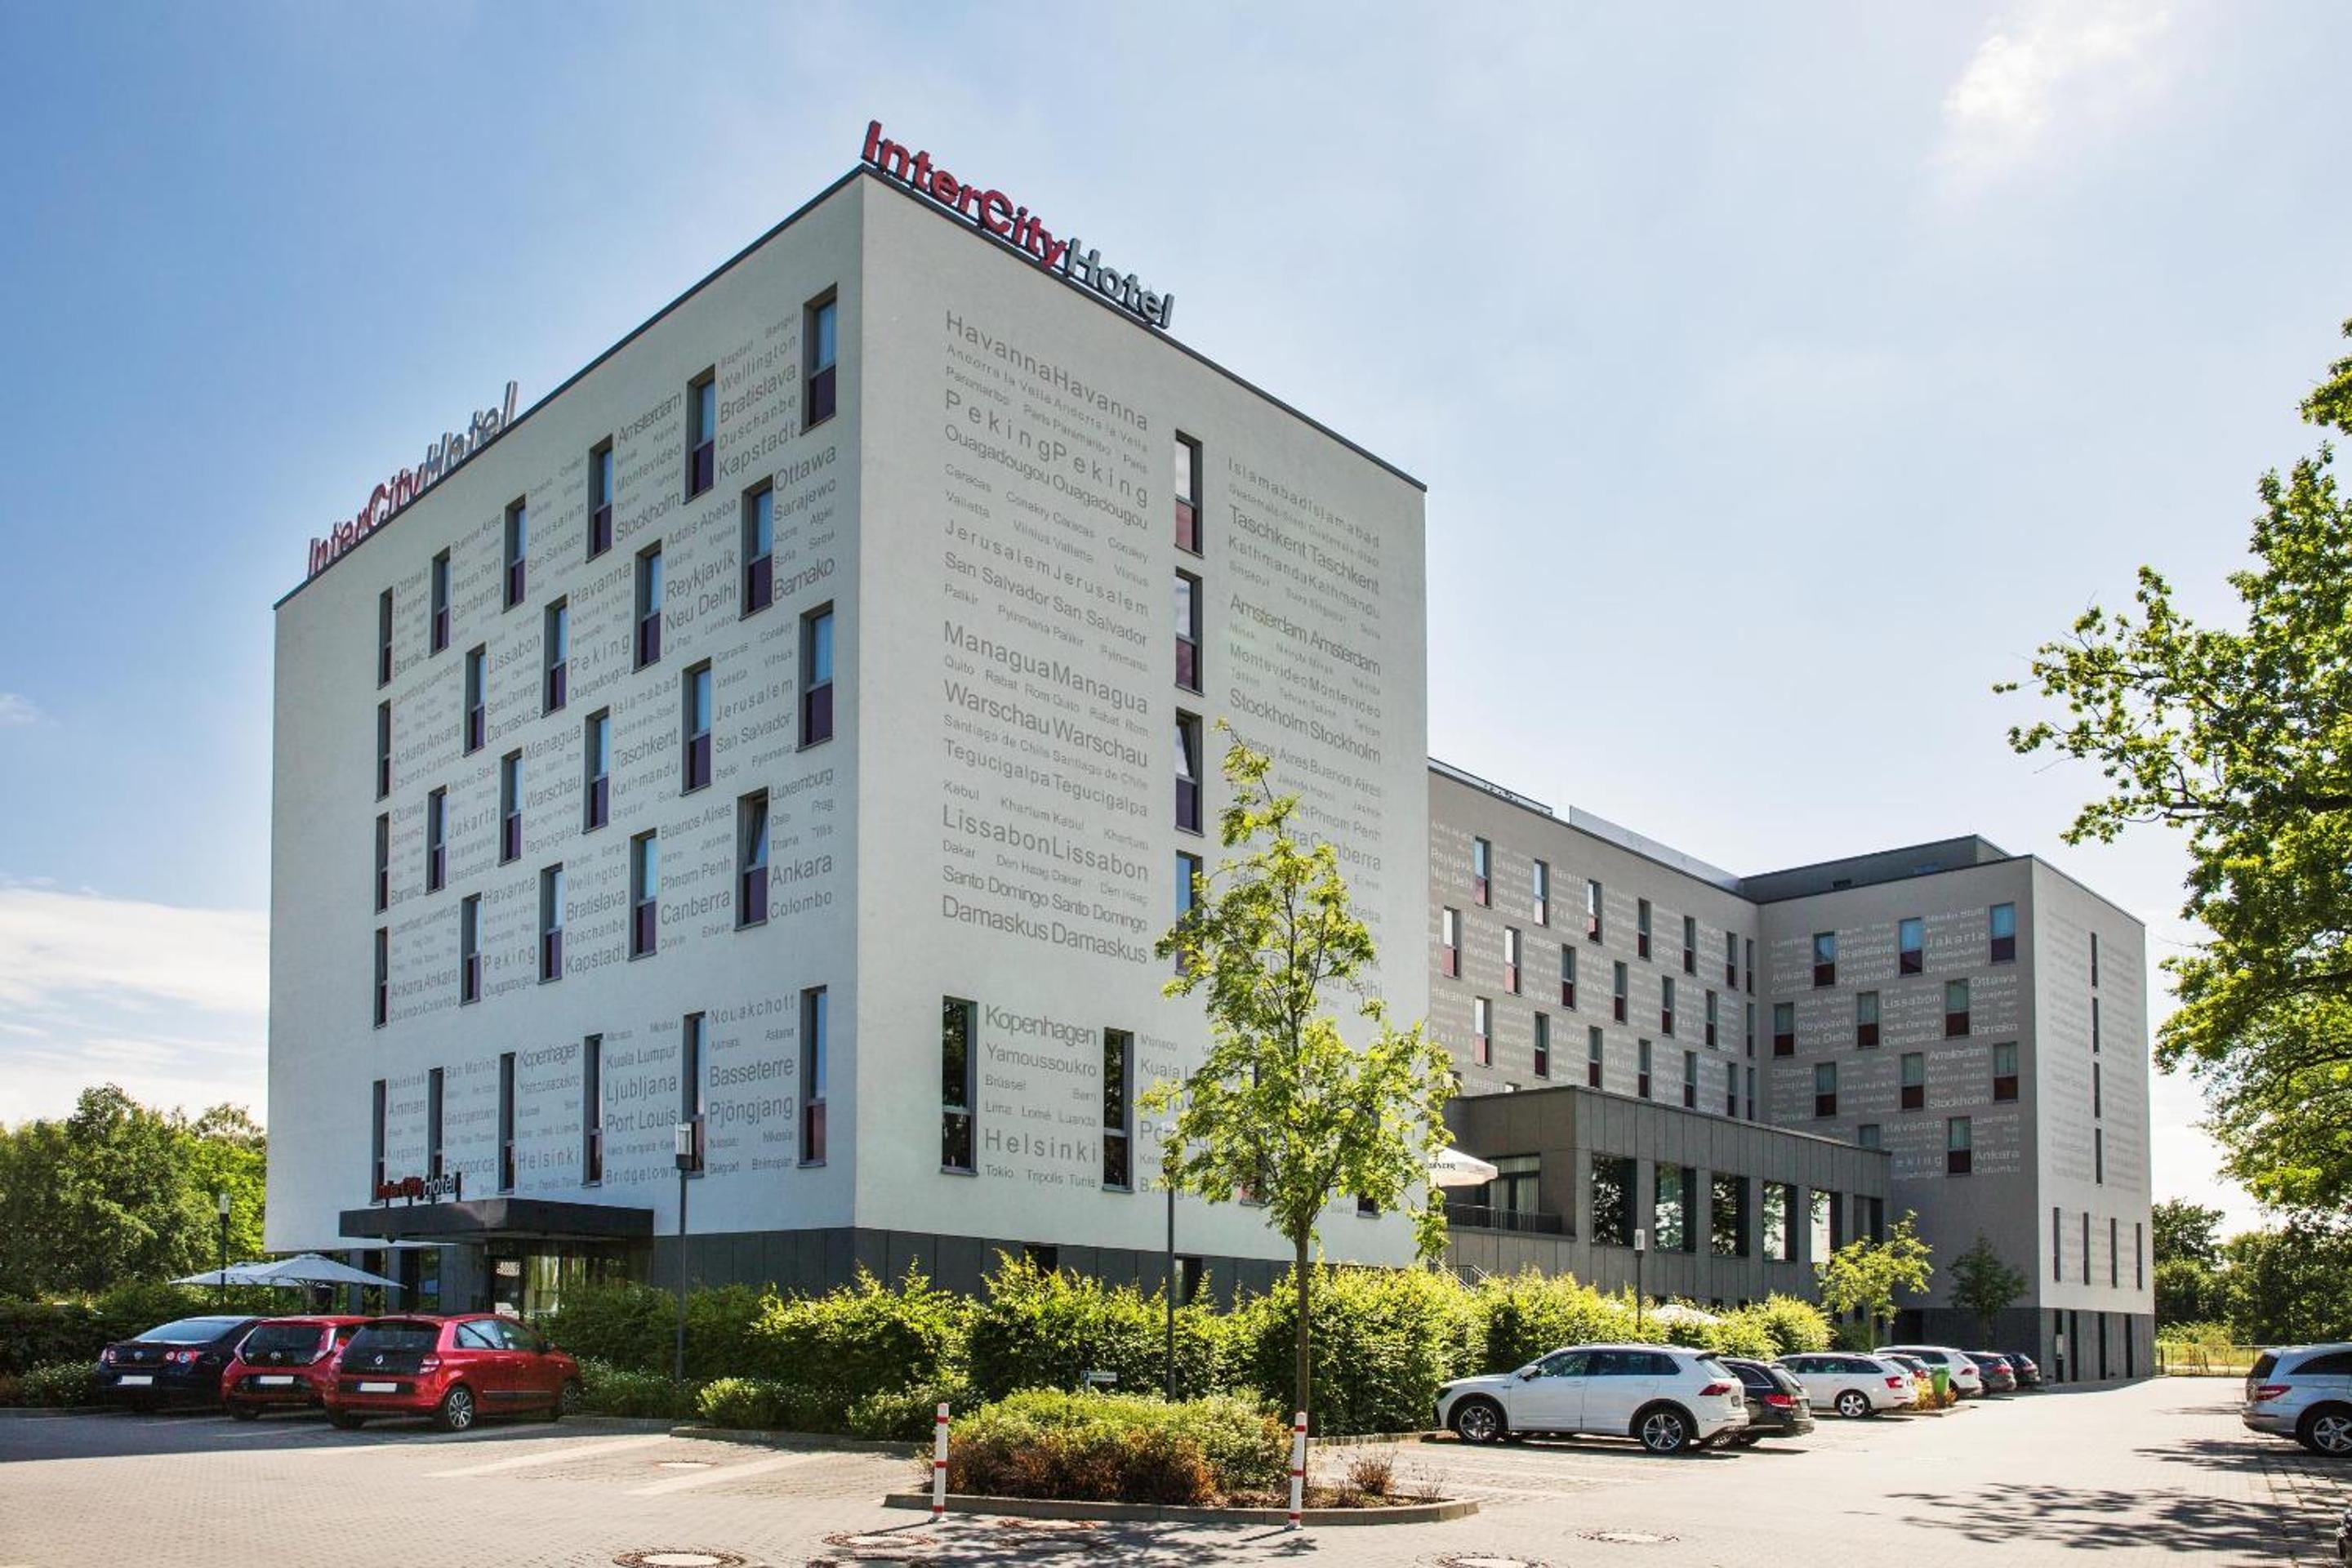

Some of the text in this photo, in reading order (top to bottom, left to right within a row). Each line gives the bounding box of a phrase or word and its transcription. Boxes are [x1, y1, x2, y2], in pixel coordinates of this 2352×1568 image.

[719, 362, 795, 425] Bratislava
[718, 416, 795, 481] Kapstadt
[774, 443, 836, 494] Ottawa
[771, 853, 832, 888] Ankara
[661, 891, 731, 926] Canberra
[986, 1003, 1096, 1047] Kopenhagen
[605, 1076, 677, 1104] Ljubljana
[710, 1058, 795, 1087] Basseterre
[605, 1111, 635, 1134] Port
[709, 1095, 793, 1127] Pjöngjang
